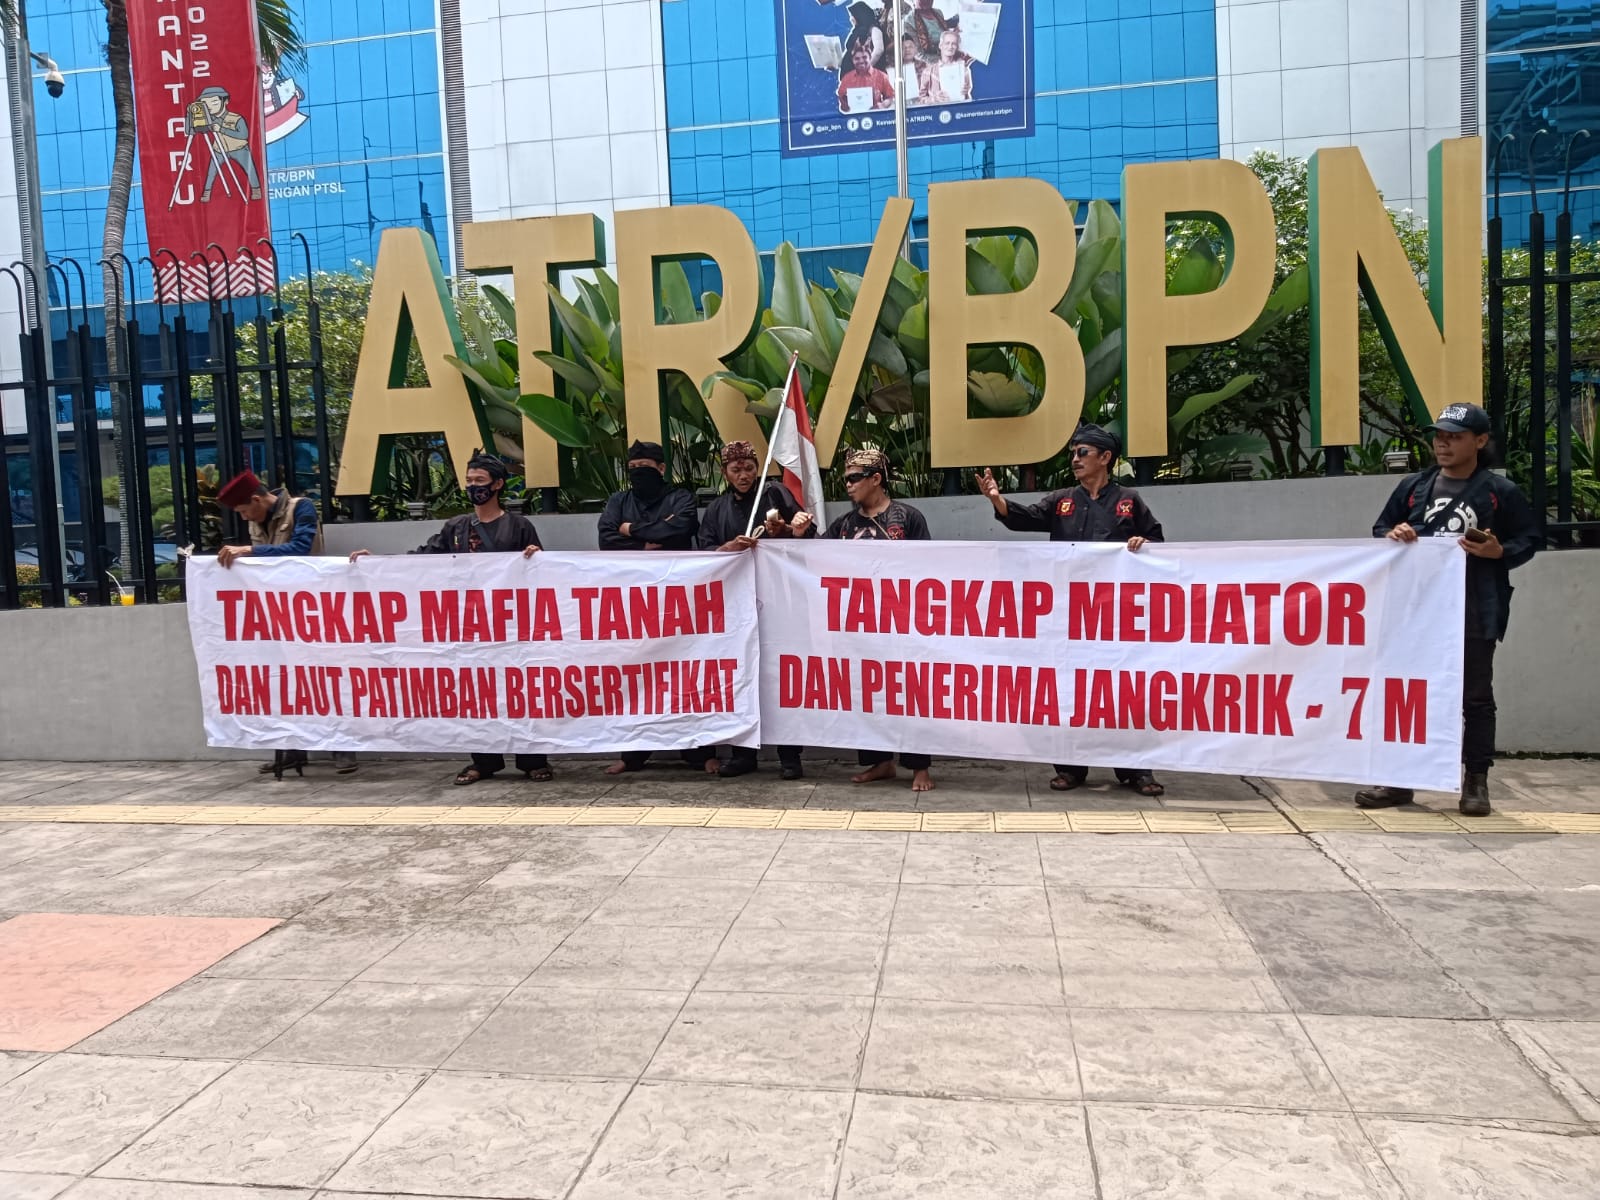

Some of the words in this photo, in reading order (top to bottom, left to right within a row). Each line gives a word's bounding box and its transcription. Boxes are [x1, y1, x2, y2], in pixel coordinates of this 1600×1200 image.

[157, 0, 195, 205] ANTARU
[313, 182, 346, 195] PTSL
[335, 136, 1482, 497] ATR/BPN
[216, 590, 408, 644] TANGKAP
[420, 587, 563, 643] MAFIA
[571, 580, 725, 641] TANAH
[820, 576, 1054, 639] TANGKAP
[1068, 581, 1366, 646] MEDIATOR
[215, 664, 271, 715] DAN
[279, 665, 343, 717] LAUT
[348, 666, 499, 719] PATIMBAN
[505, 658, 738, 720] BERSERTIFIKAT
[779, 654, 852, 711] DAN
[861, 659, 1060, 727] PENERIMA
[1069, 668, 1294, 737] JANGKRIK
[1306, 704, 1323, 719] -
[1342, 677, 1370, 740] 7
[1384, 677, 1427, 744] M
